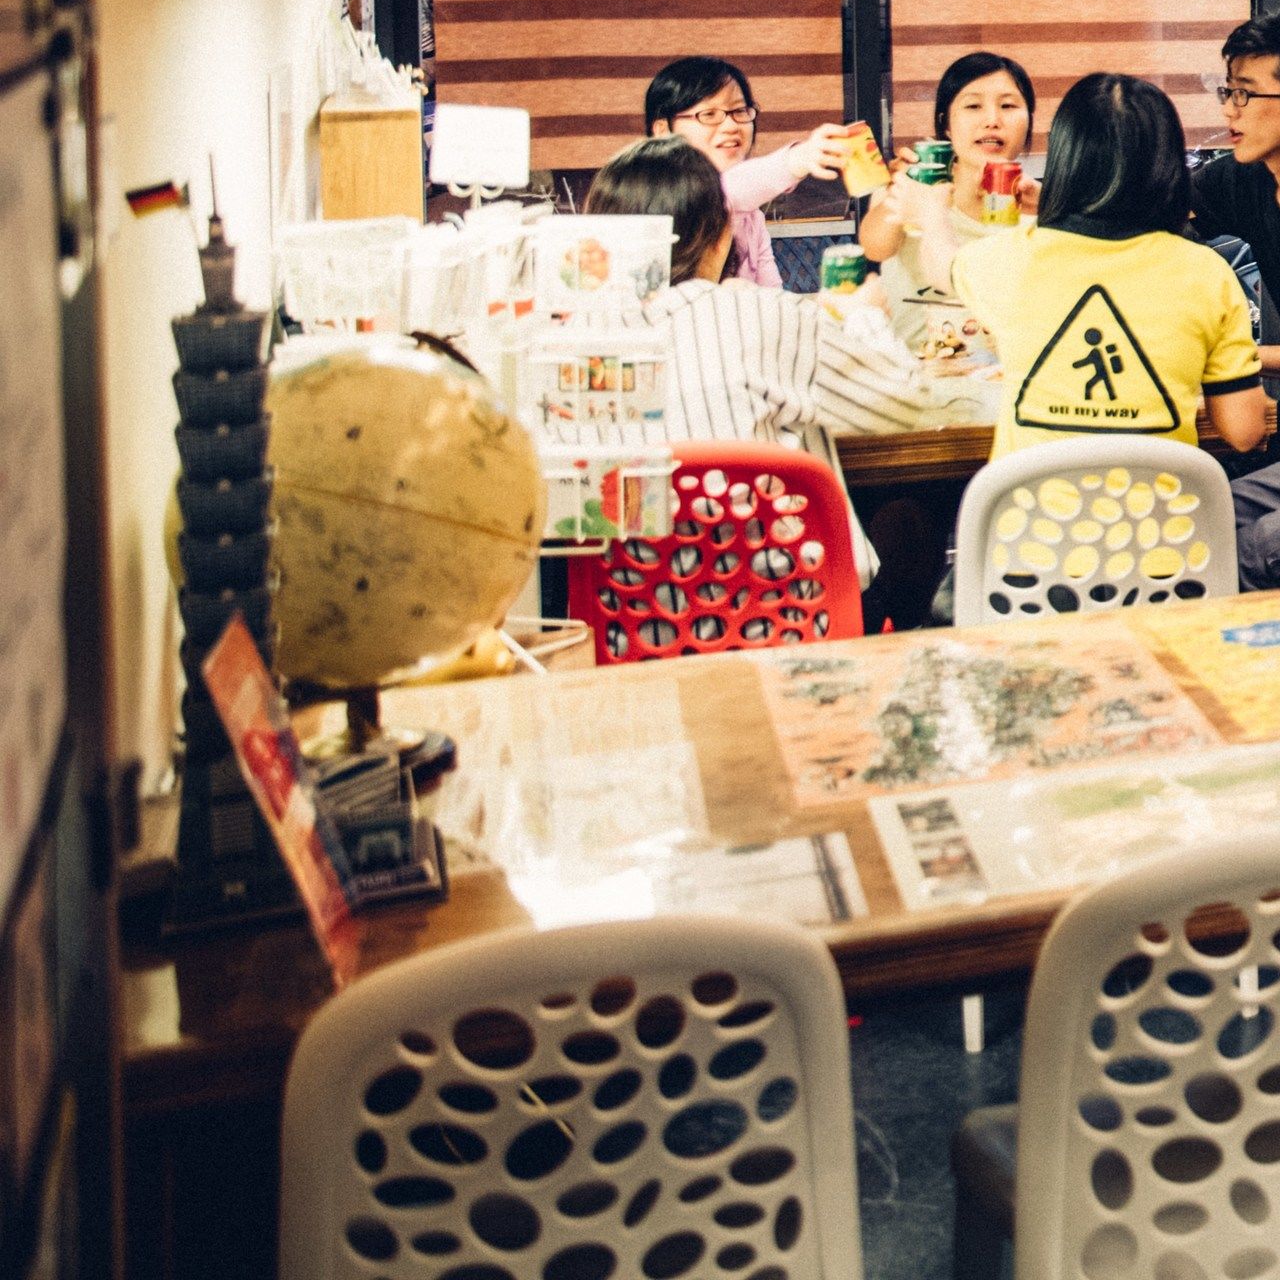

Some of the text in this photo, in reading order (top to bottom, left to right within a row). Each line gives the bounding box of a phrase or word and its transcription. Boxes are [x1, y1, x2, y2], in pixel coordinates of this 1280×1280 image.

[1048, 405, 1140, 419] on my way
